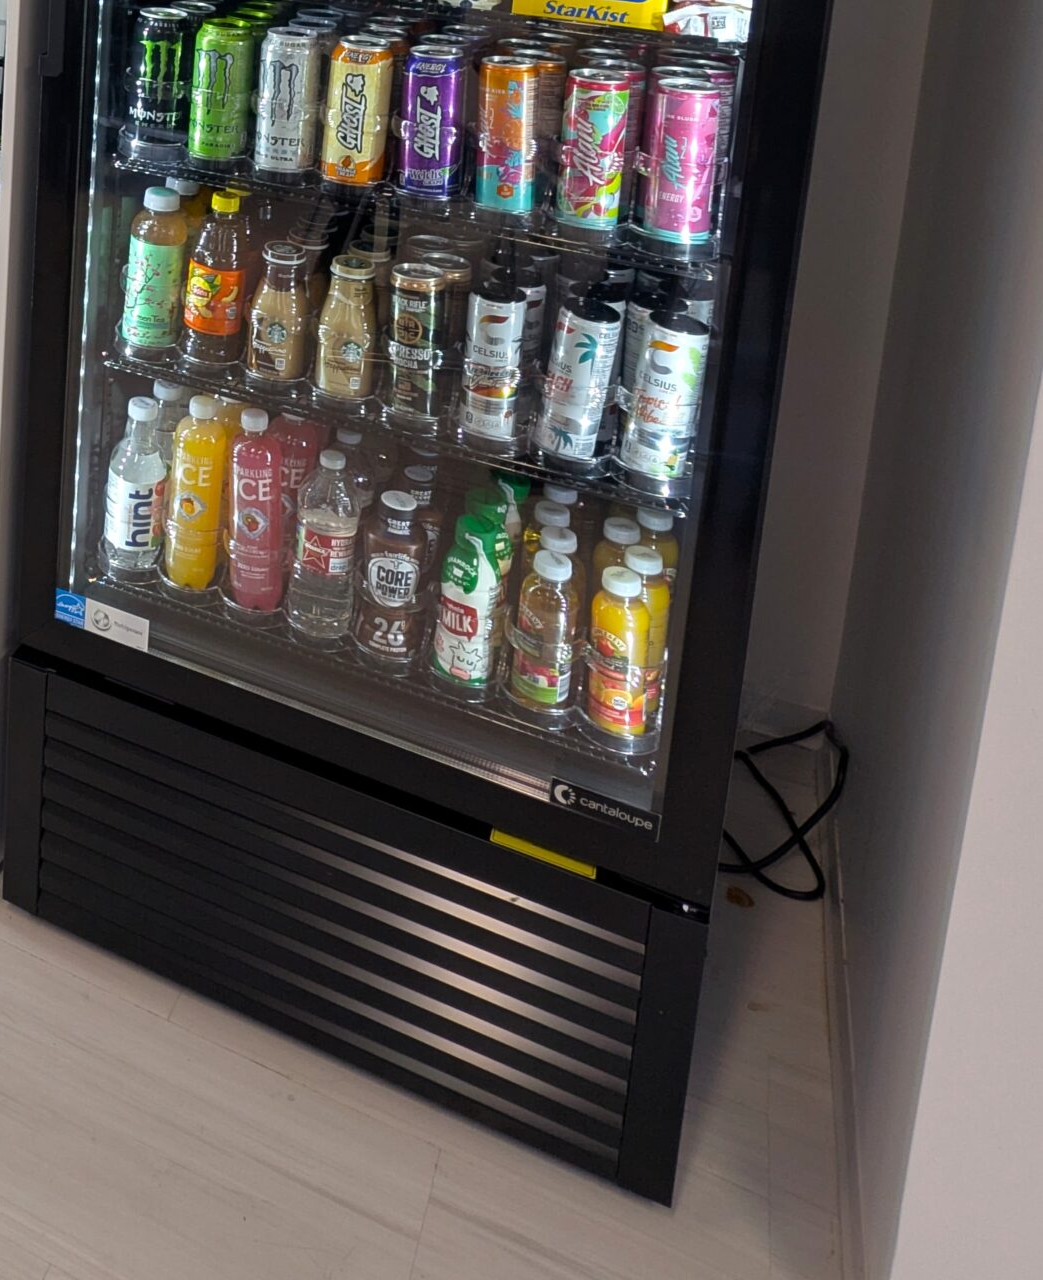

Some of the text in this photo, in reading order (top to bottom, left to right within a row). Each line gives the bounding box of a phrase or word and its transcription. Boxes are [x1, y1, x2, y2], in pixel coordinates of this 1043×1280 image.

[542, 0, 631, 24] StarKist
[279, 40, 307, 48] SUGAR
[415, 61, 447, 73] ENERGY
[129, 106, 182, 124] MONST
[336, 81, 367, 154] GHOST
[413, 95, 442, 162] GHOST
[270, 155, 293, 163] ULTRA
[571, 112, 608, 188] Alani
[659, 132, 689, 192] Alani
[409, 168, 444, 182] Welch's
[408, 298, 428, 310] RIFLE
[389, 342, 431, 361] PRESSO
[639, 371, 678, 392] CELSIUS
[180, 463, 214, 487] CE
[238, 478, 274, 502] CE
[125, 487, 154, 548] hint
[387, 518, 411, 528] GREAT
[376, 565, 414, 587] CORE
[375, 581, 412, 599] POWER
[442, 608, 473, 634] MILK
[578, 795, 654, 831] cantaloupe
